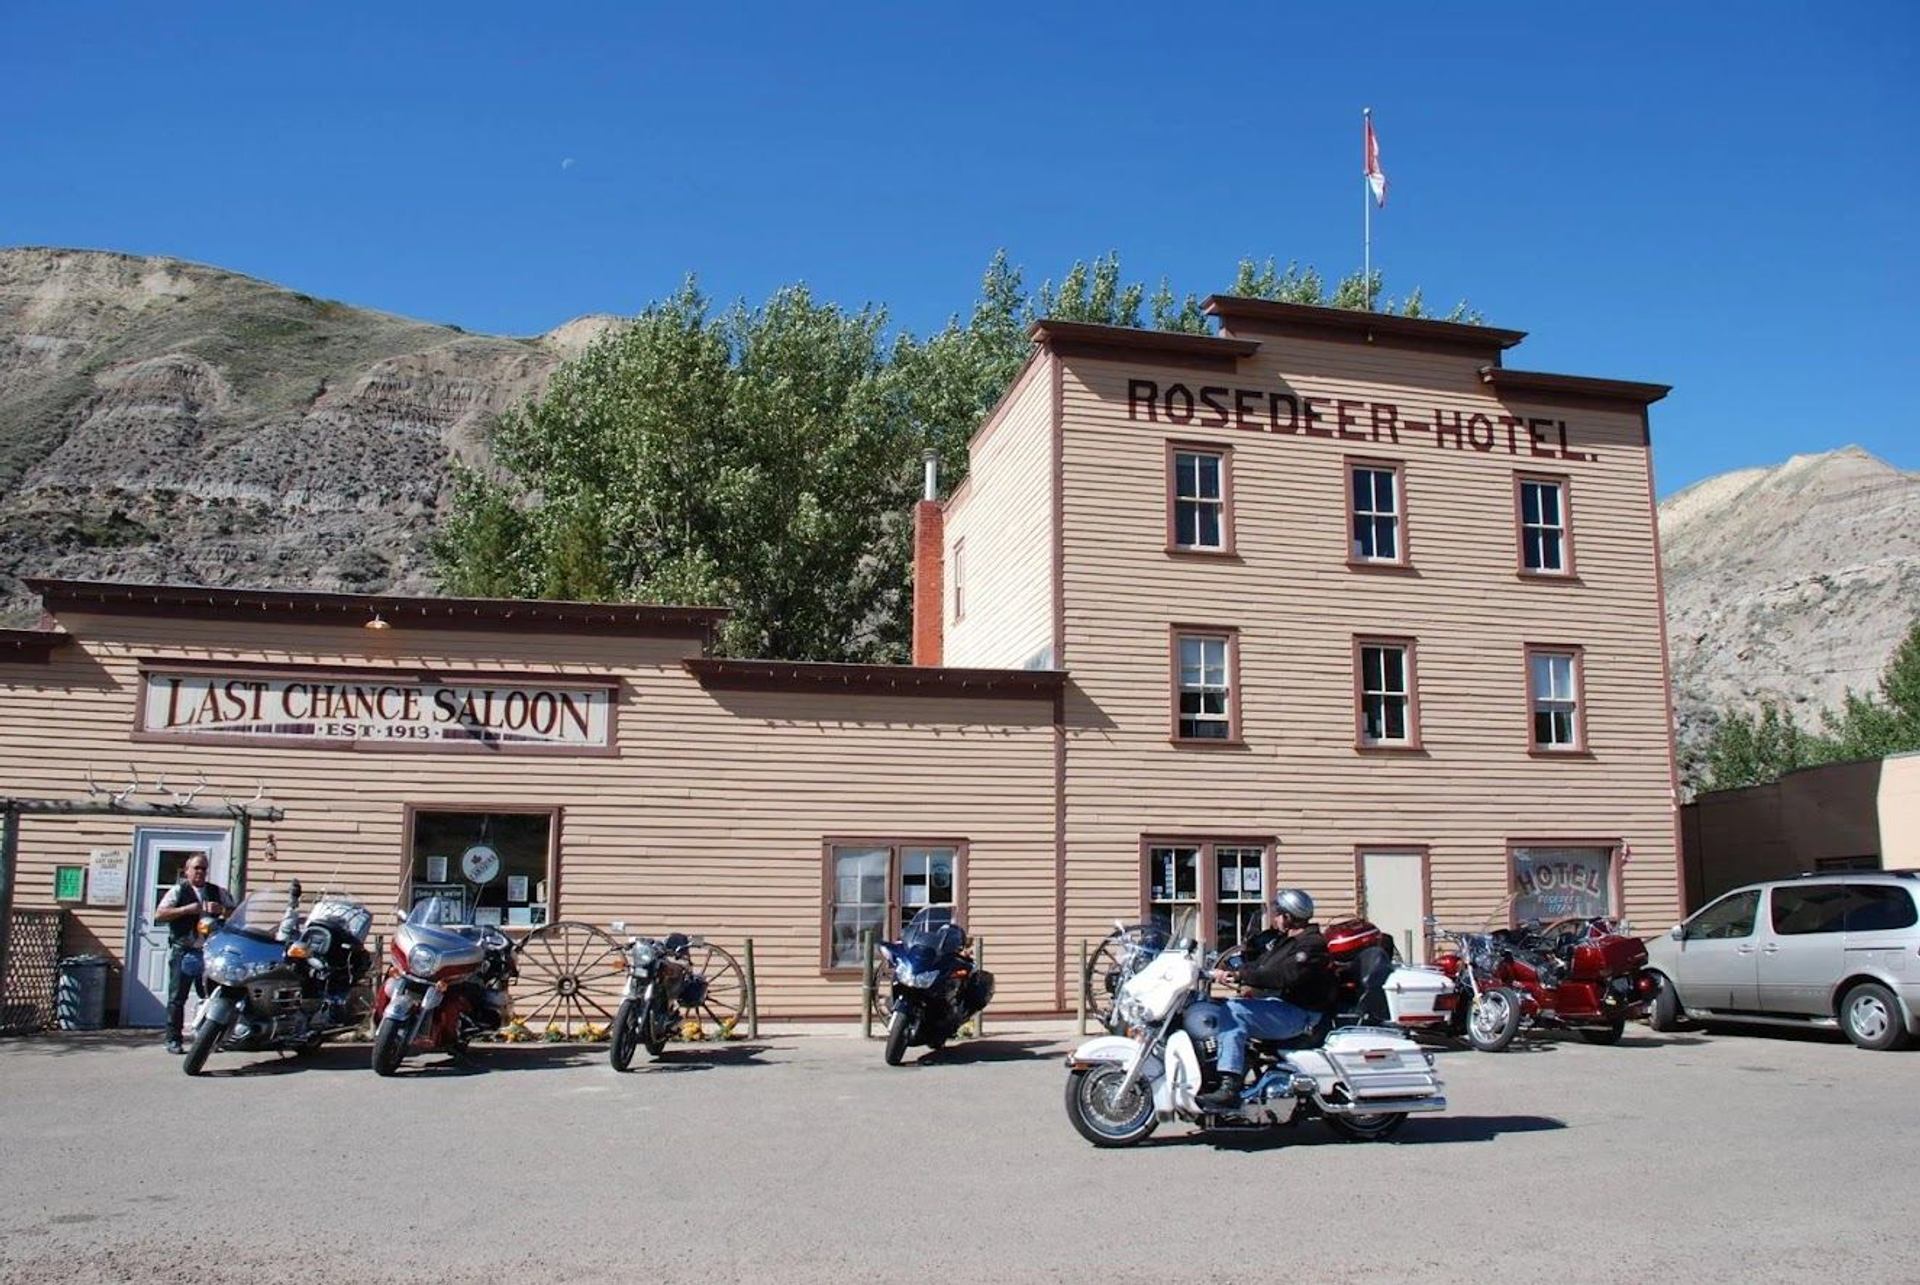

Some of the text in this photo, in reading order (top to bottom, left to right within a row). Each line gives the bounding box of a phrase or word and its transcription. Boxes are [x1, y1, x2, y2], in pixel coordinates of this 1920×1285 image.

[164, 678, 592, 739] LAST CHANCE SALOON
[1517, 863, 1601, 898] HOTEL
